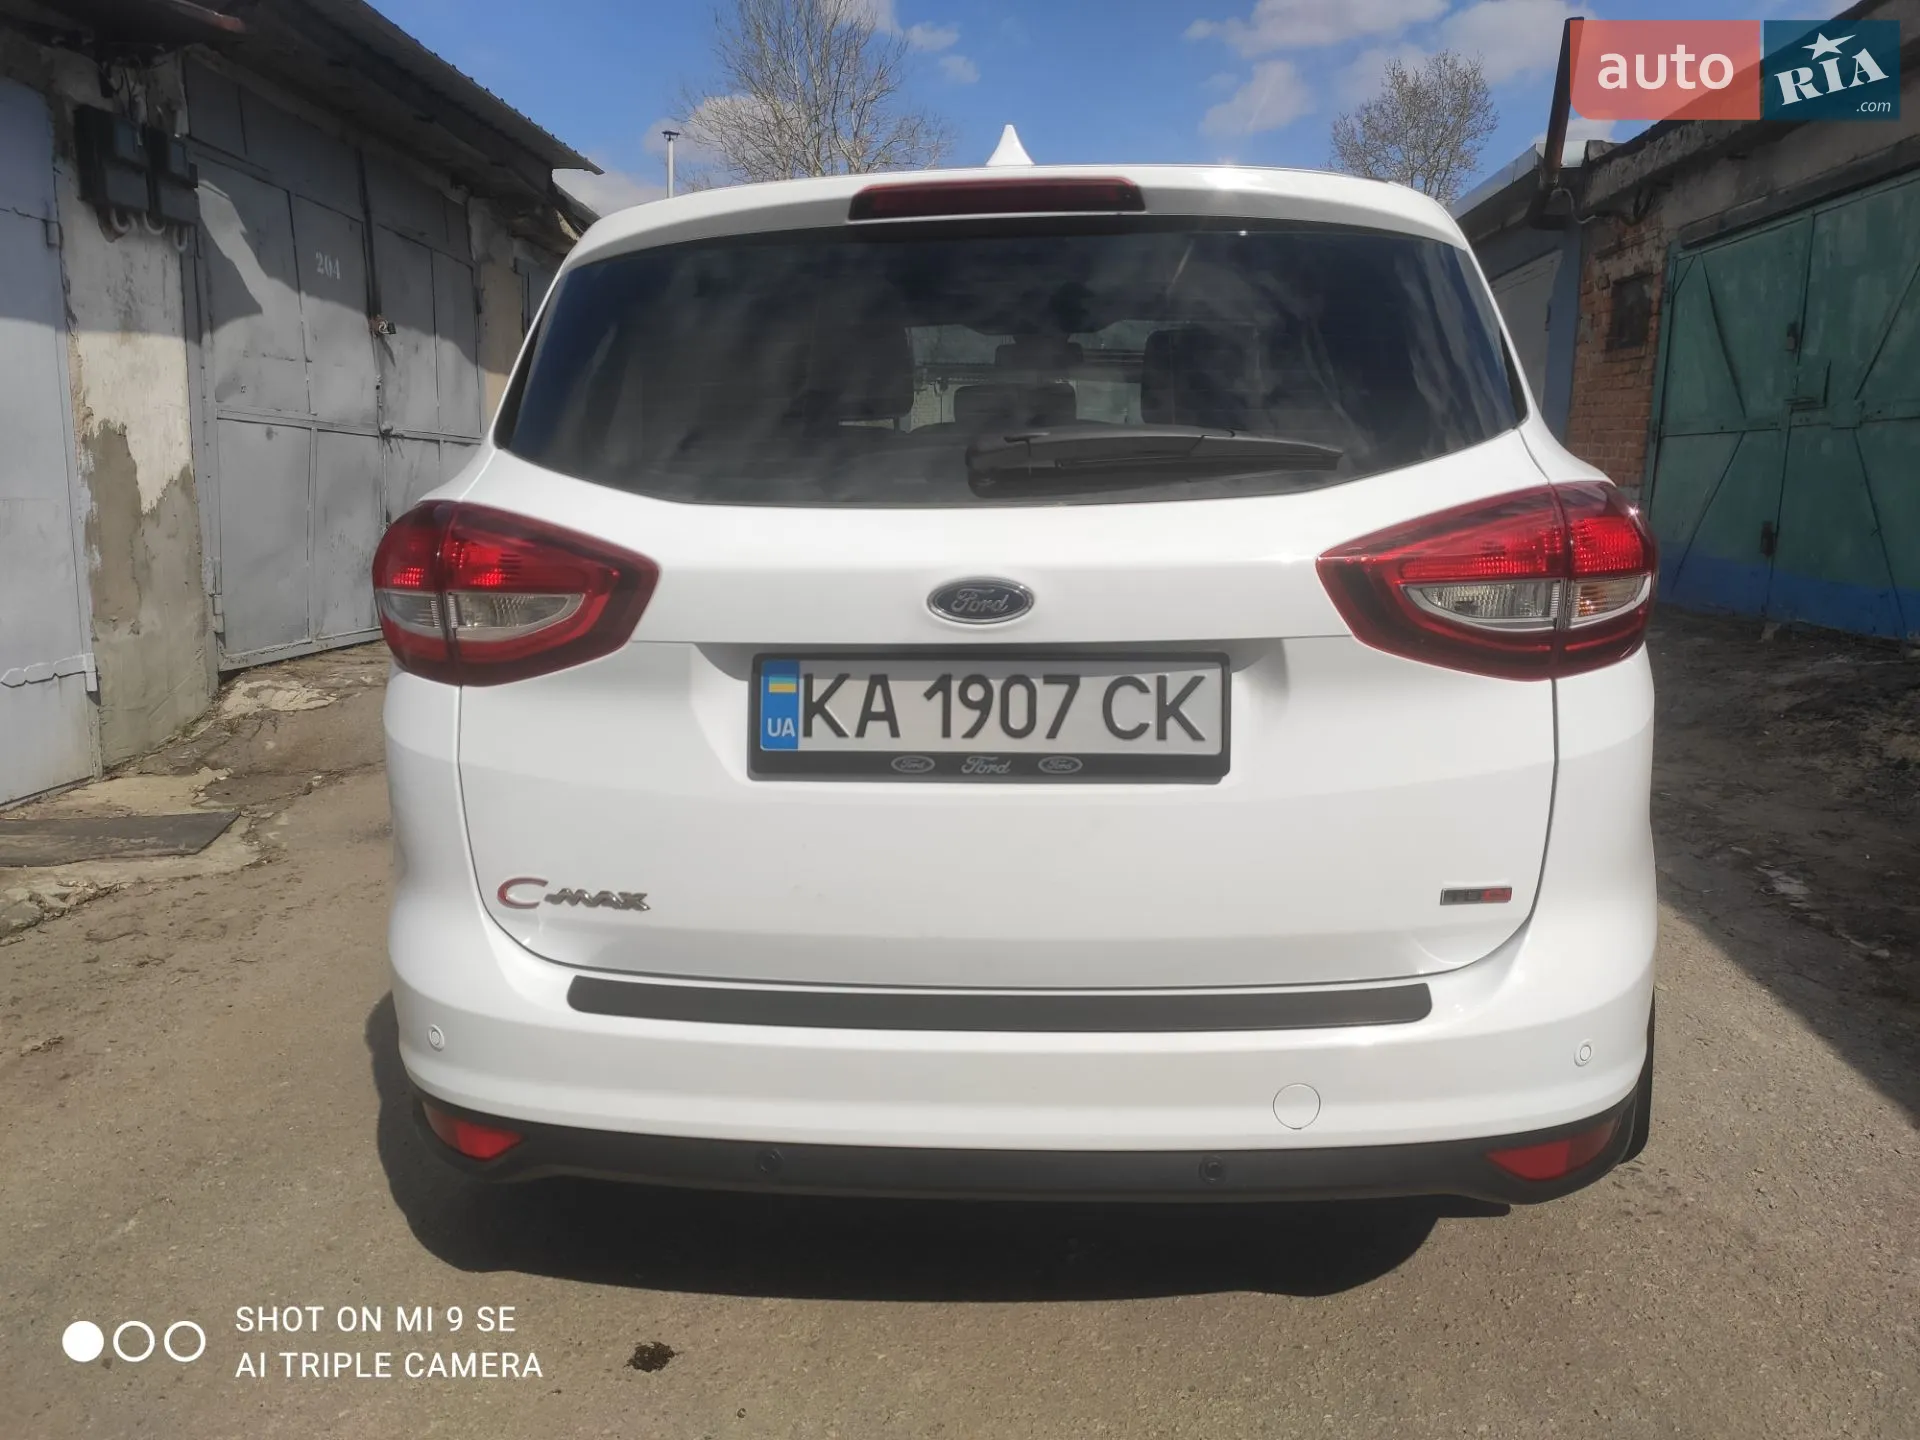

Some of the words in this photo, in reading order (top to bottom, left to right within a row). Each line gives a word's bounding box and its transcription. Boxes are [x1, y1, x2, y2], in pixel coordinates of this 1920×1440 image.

[950, 587, 1009, 614] Ford
[803, 673, 900, 739] KA
[923, 673, 1081, 740] 1907
[1102, 674, 1206, 741] CK
[767, 717, 796, 738] UA
[961, 756, 1011, 776] Ford
